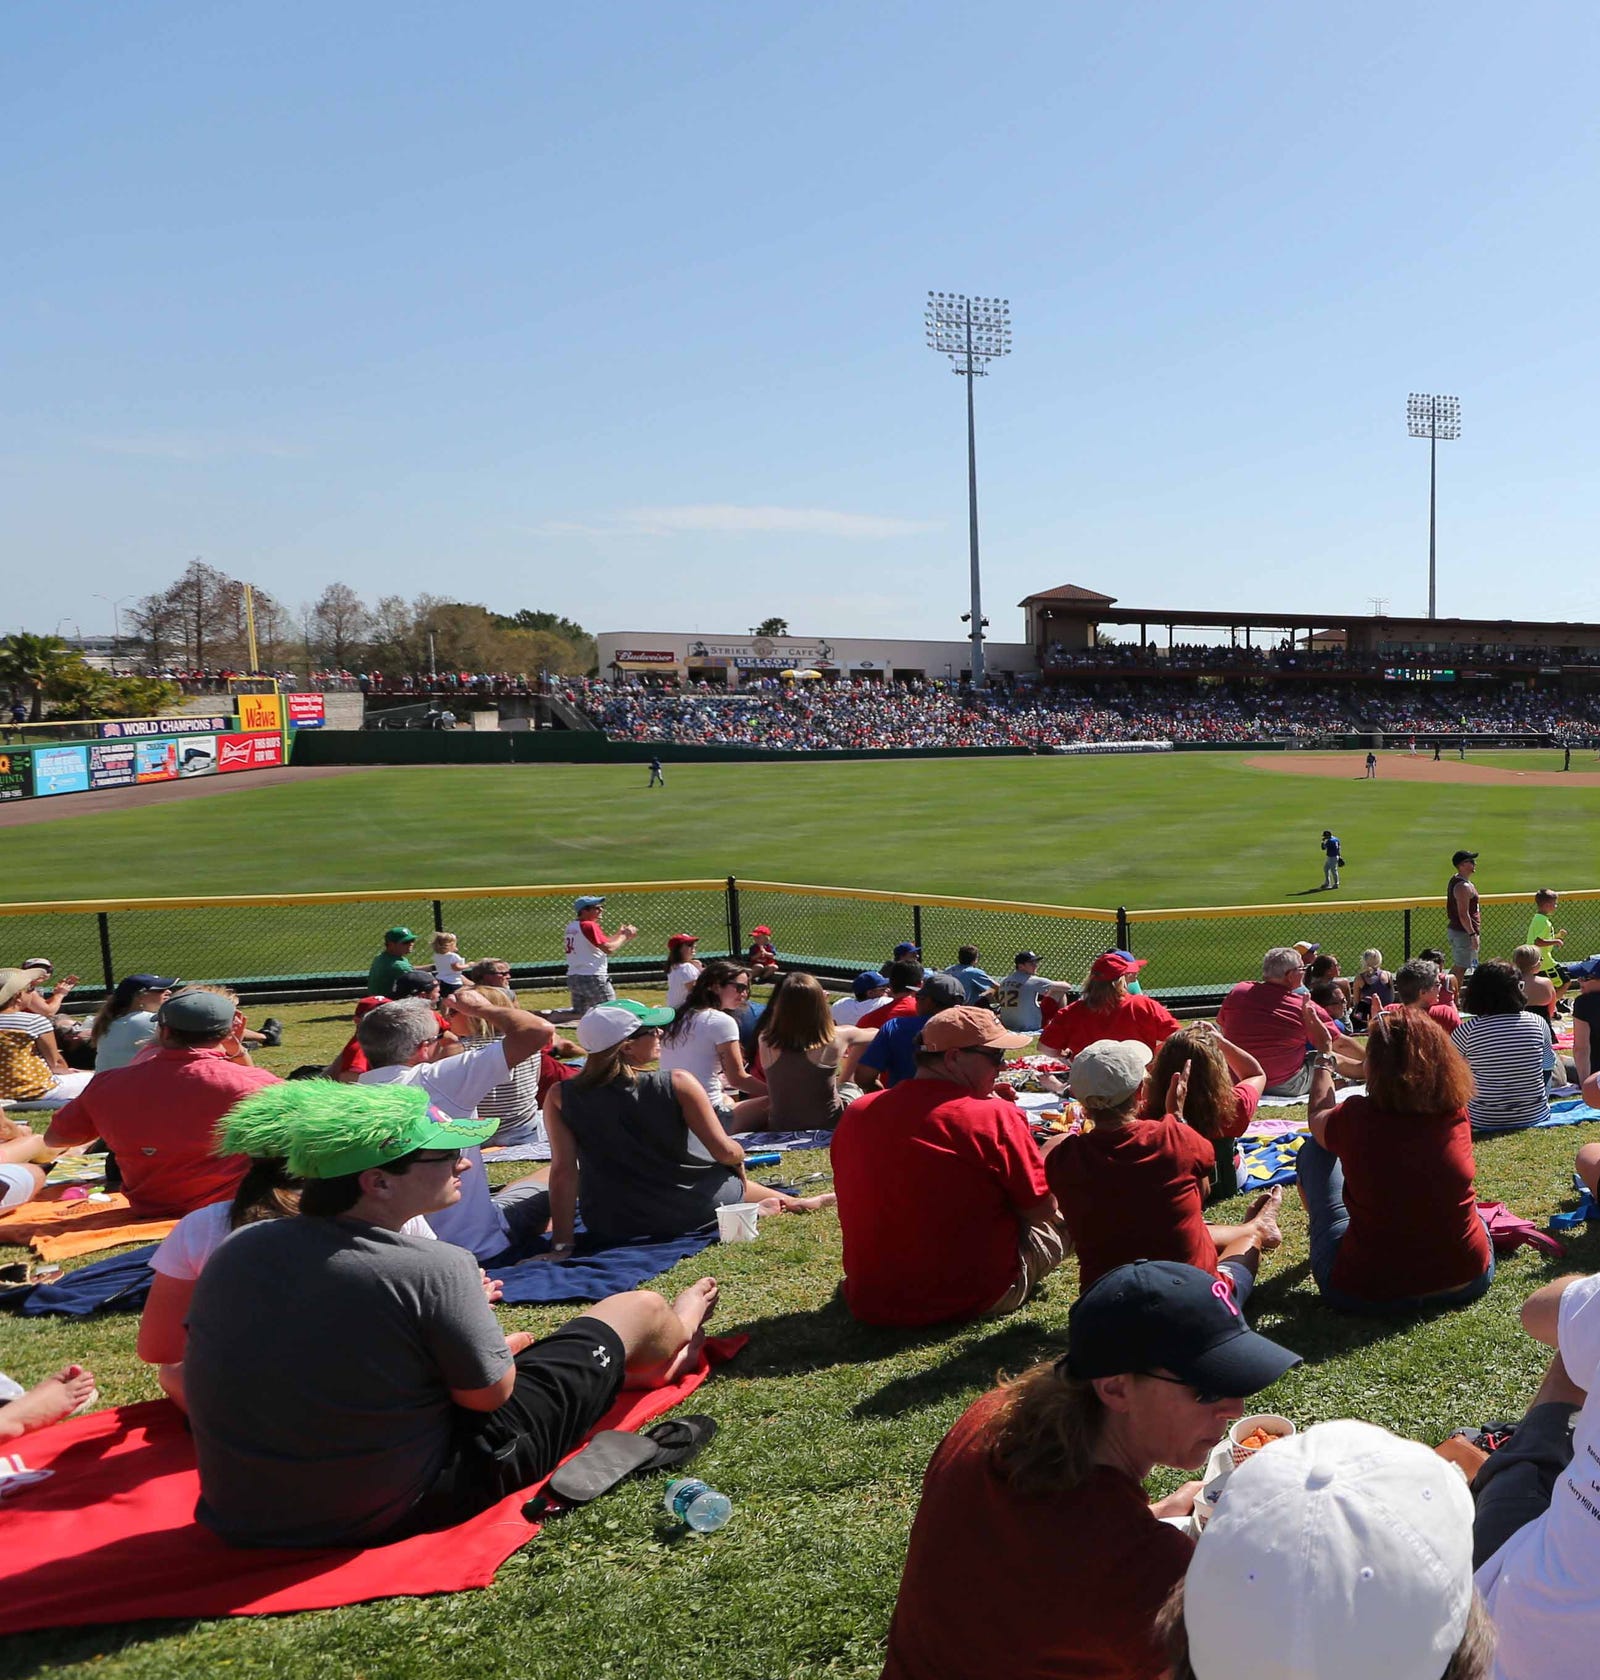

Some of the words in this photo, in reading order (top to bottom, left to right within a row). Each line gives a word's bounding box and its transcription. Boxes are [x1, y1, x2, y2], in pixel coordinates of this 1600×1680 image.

[617, 651, 673, 662] Budweiser
[711, 646, 748, 655] STRIKE
[246, 708, 276, 729] Wawa
[122, 721, 159, 736] WORLD
[160, 719, 212, 733] CHAMPIONS
[0, 775, 25, 784] UINTA
[1211, 1280, 1238, 1316] P
[1581, 1495, 1593, 1511] Hill
